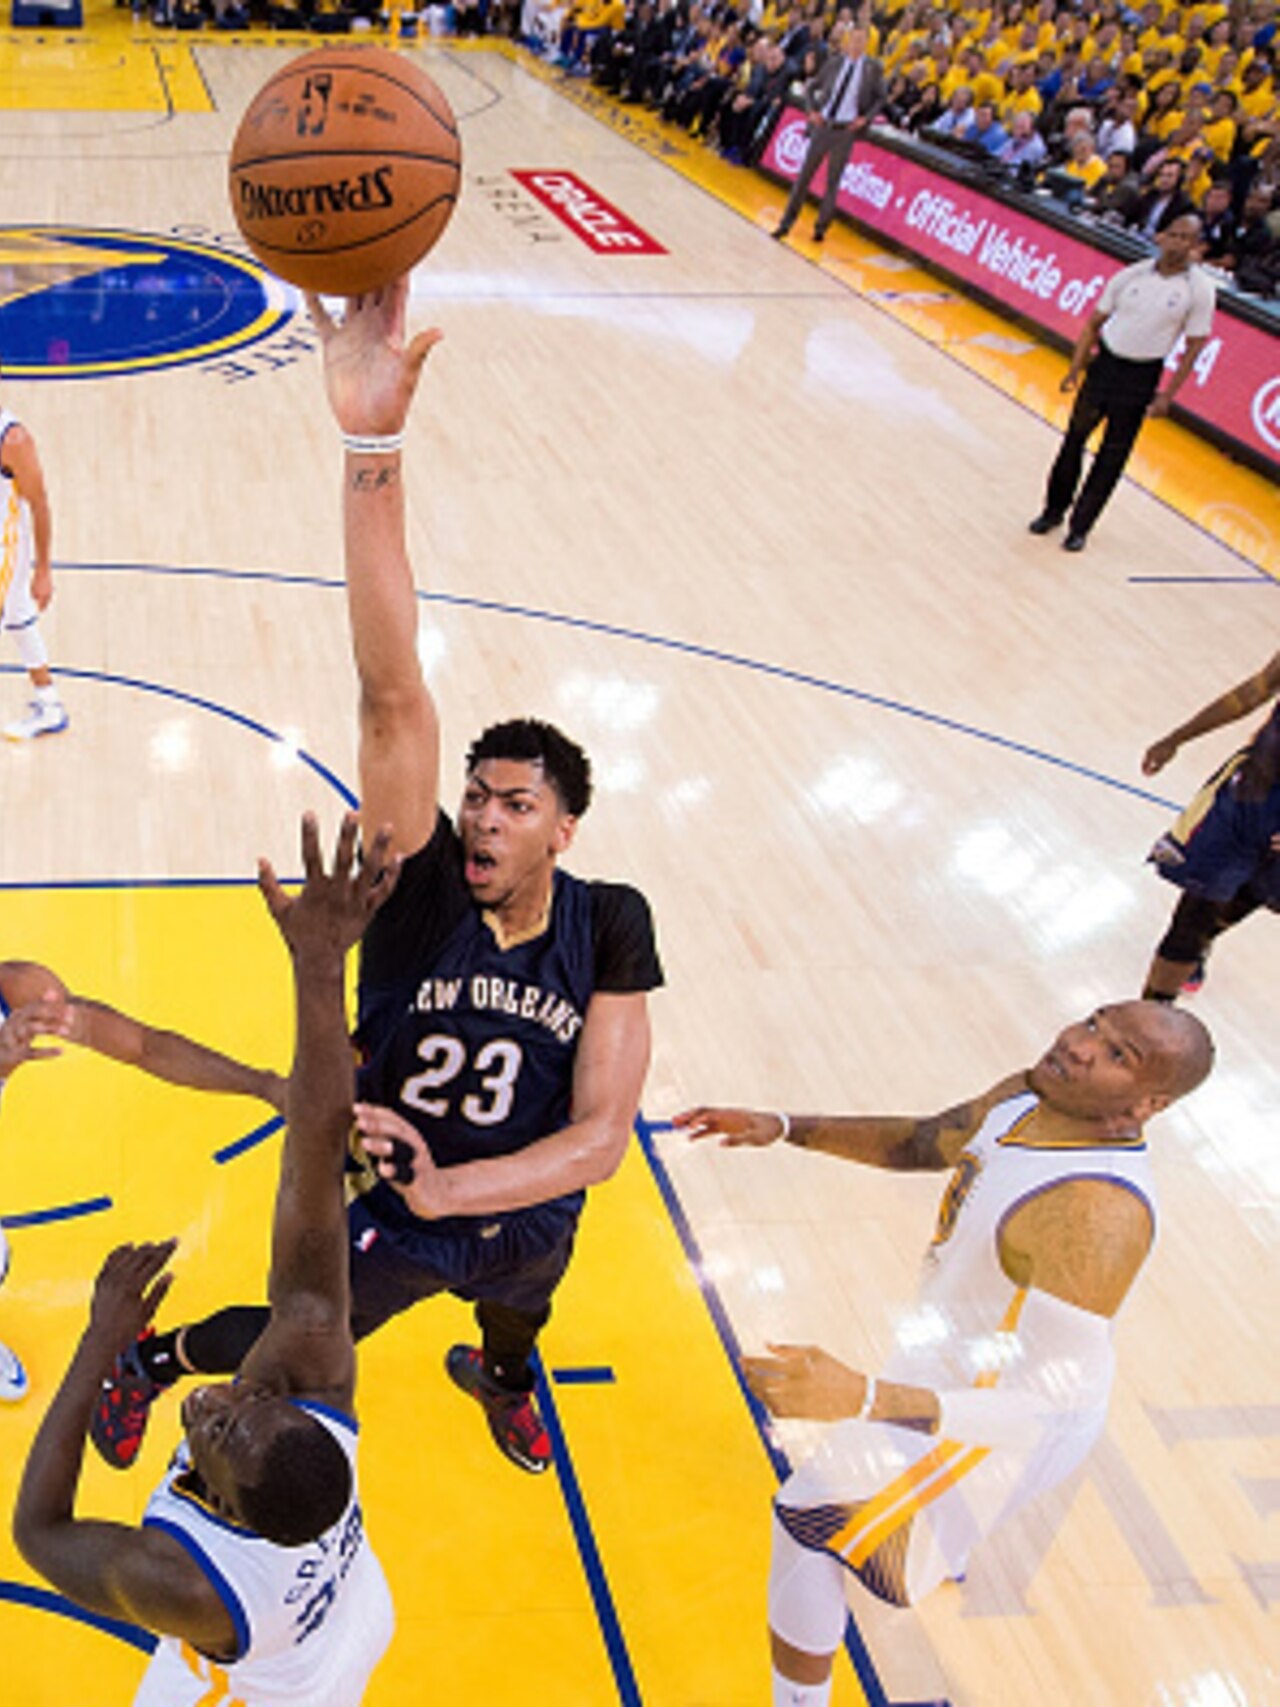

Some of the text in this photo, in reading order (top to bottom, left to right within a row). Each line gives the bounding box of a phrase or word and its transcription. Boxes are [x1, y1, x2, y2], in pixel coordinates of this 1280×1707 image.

[238, 165, 394, 220] SPALDING
[904, 188, 987, 256] Official
[978, 222, 1062, 299] Vehicle
[1057, 275, 1105, 318] of
[408, 975, 583, 1044] EW ORLEANS
[400, 1033, 523, 1126] 23
